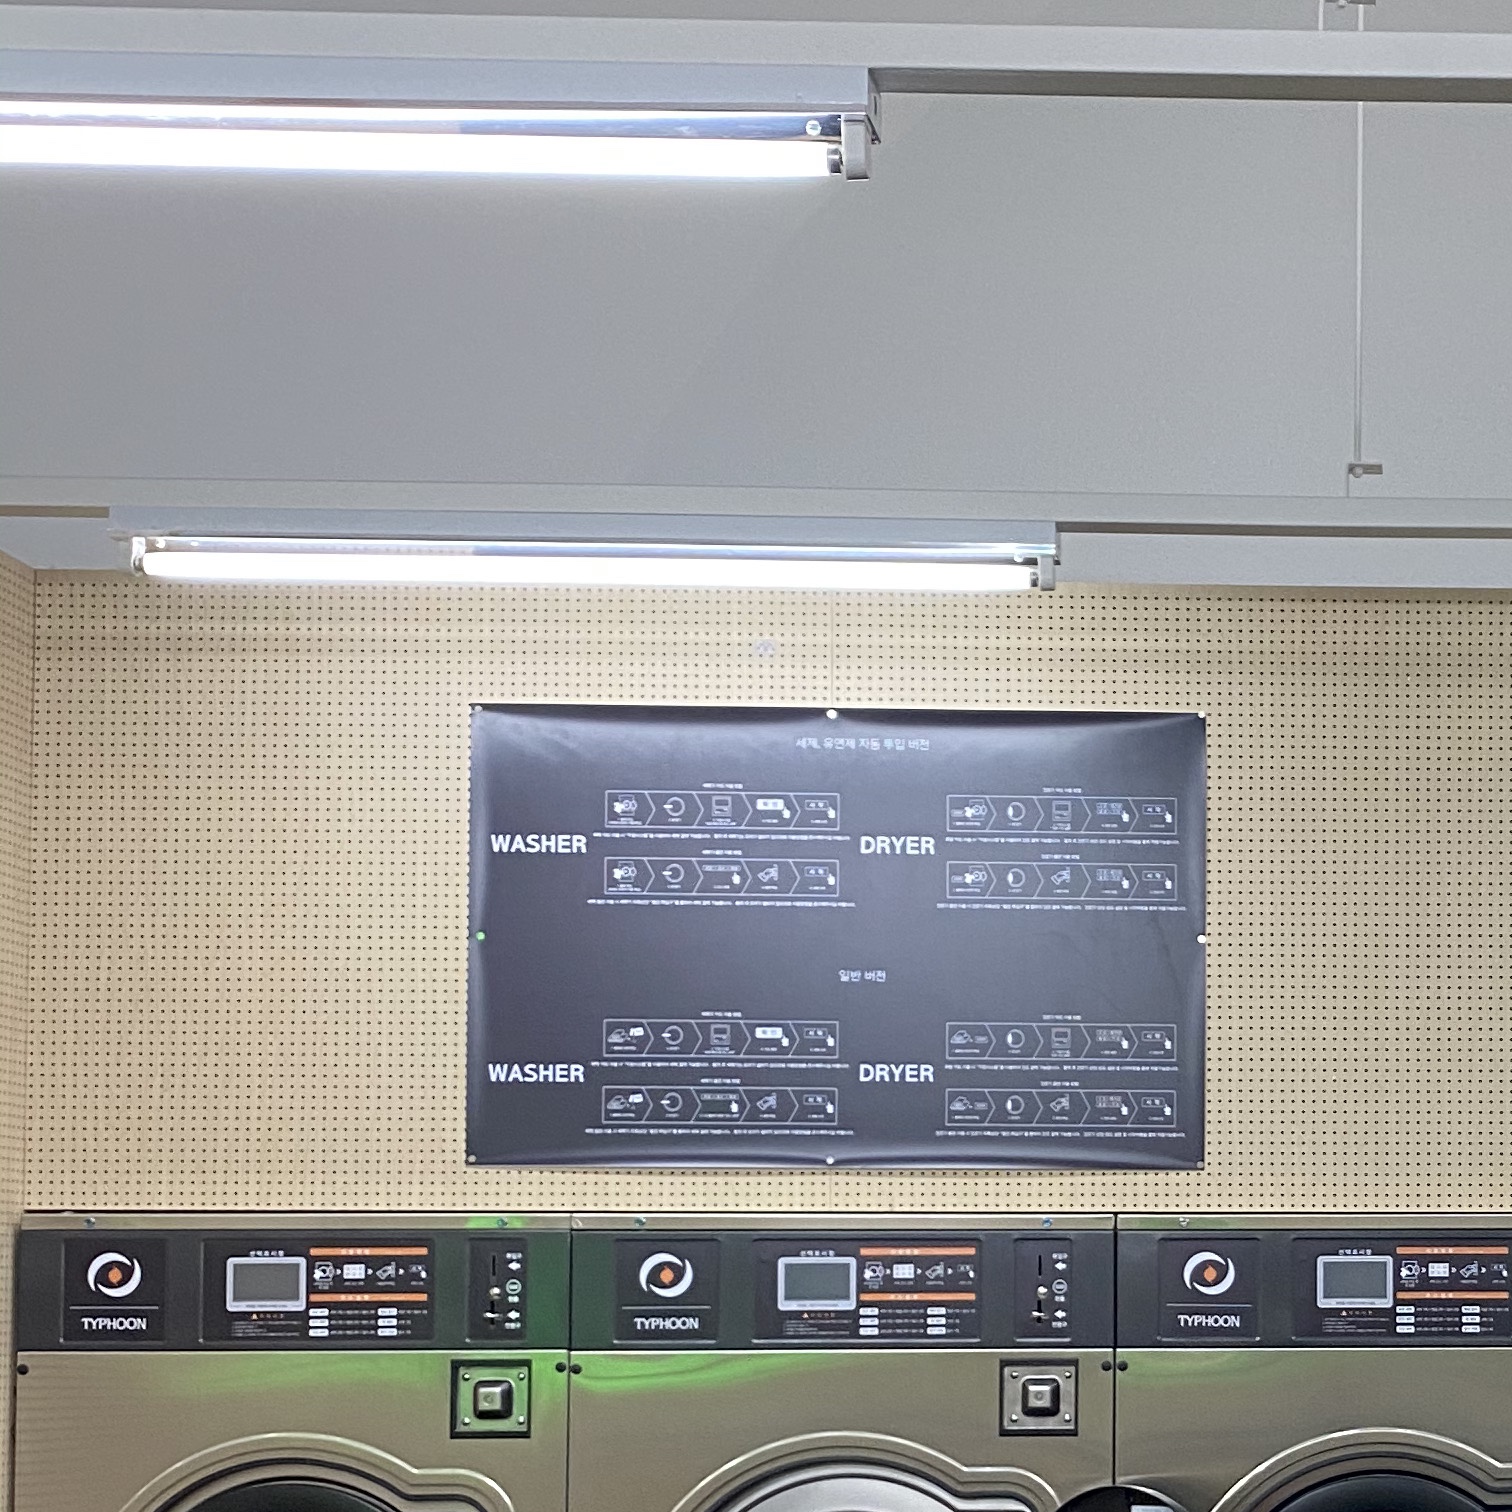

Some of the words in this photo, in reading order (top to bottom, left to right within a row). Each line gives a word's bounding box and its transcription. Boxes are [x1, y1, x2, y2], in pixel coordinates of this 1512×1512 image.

[490, 834, 588, 854] WASHER
[859, 836, 936, 855] DRYER
[838, 970, 861, 983] 일반
[864, 970, 886, 983] 버전
[488, 1063, 585, 1083] WASHER
[858, 1064, 935, 1083] DRYER
[81, 1317, 147, 1331] TYPHOON
[634, 1317, 699, 1330] TYPHOON
[1177, 1314, 1240, 1328] TYPHOON
